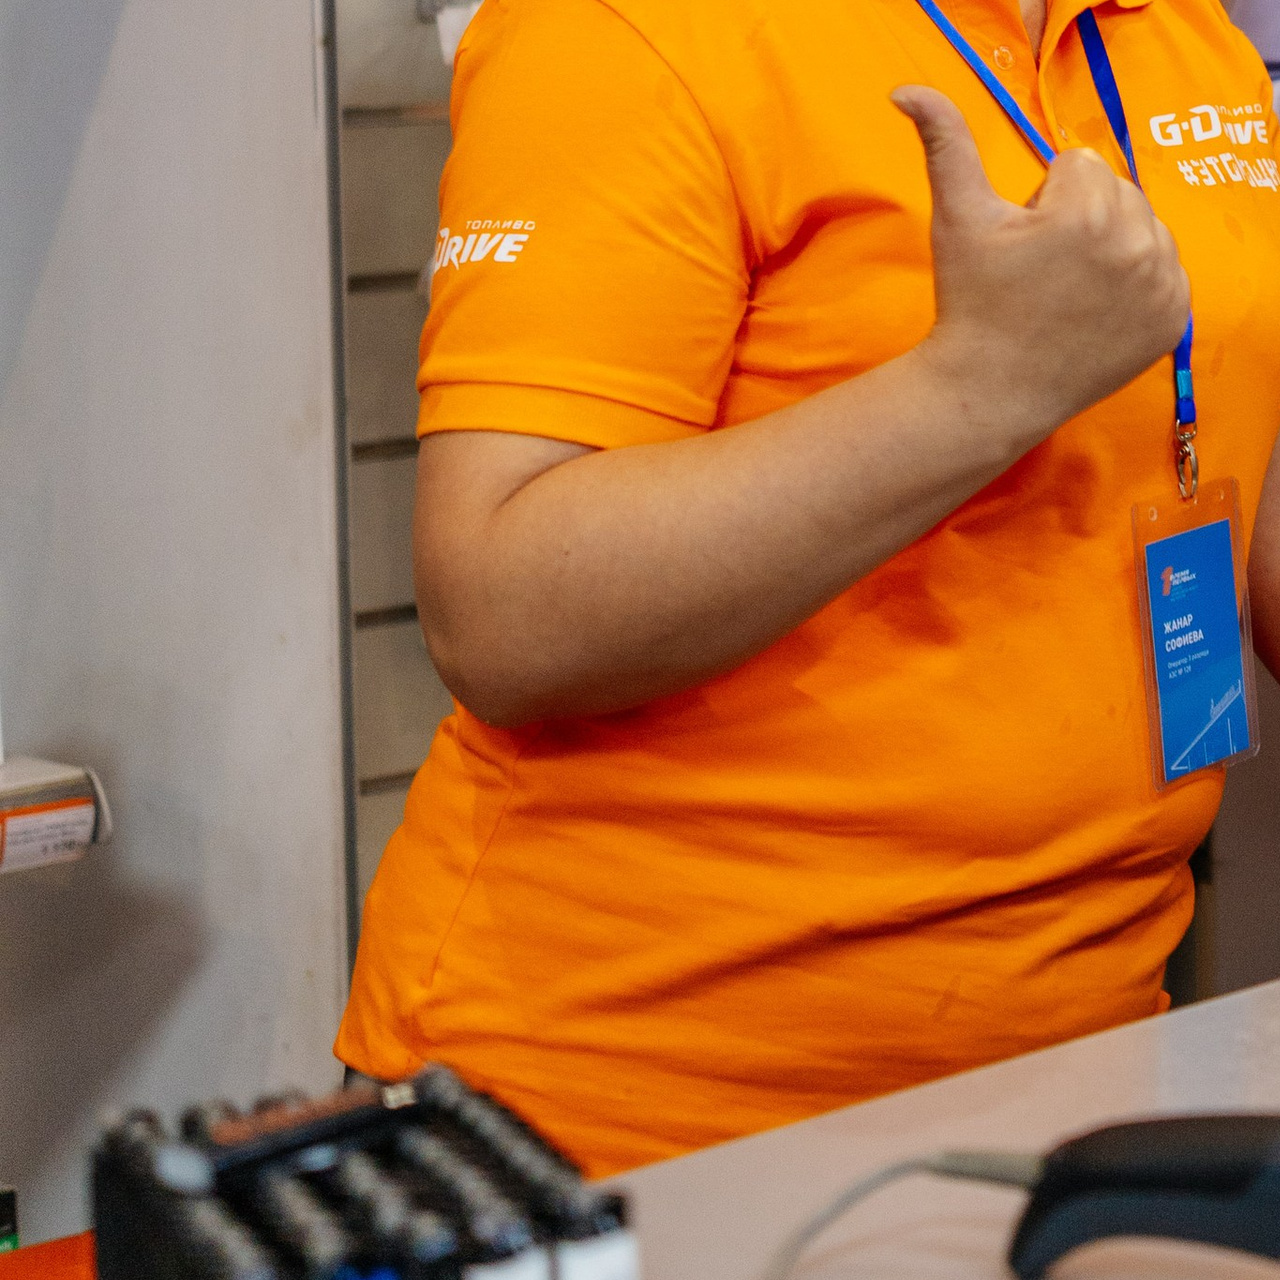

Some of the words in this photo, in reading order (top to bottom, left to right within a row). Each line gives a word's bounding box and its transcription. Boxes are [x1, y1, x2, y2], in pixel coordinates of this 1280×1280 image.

[466, 220, 536, 231] ТОПЛИВО
[1163, 613, 1193, 635] ЖАНАР
[1165, 629, 1205, 653] СОФИЕВА
